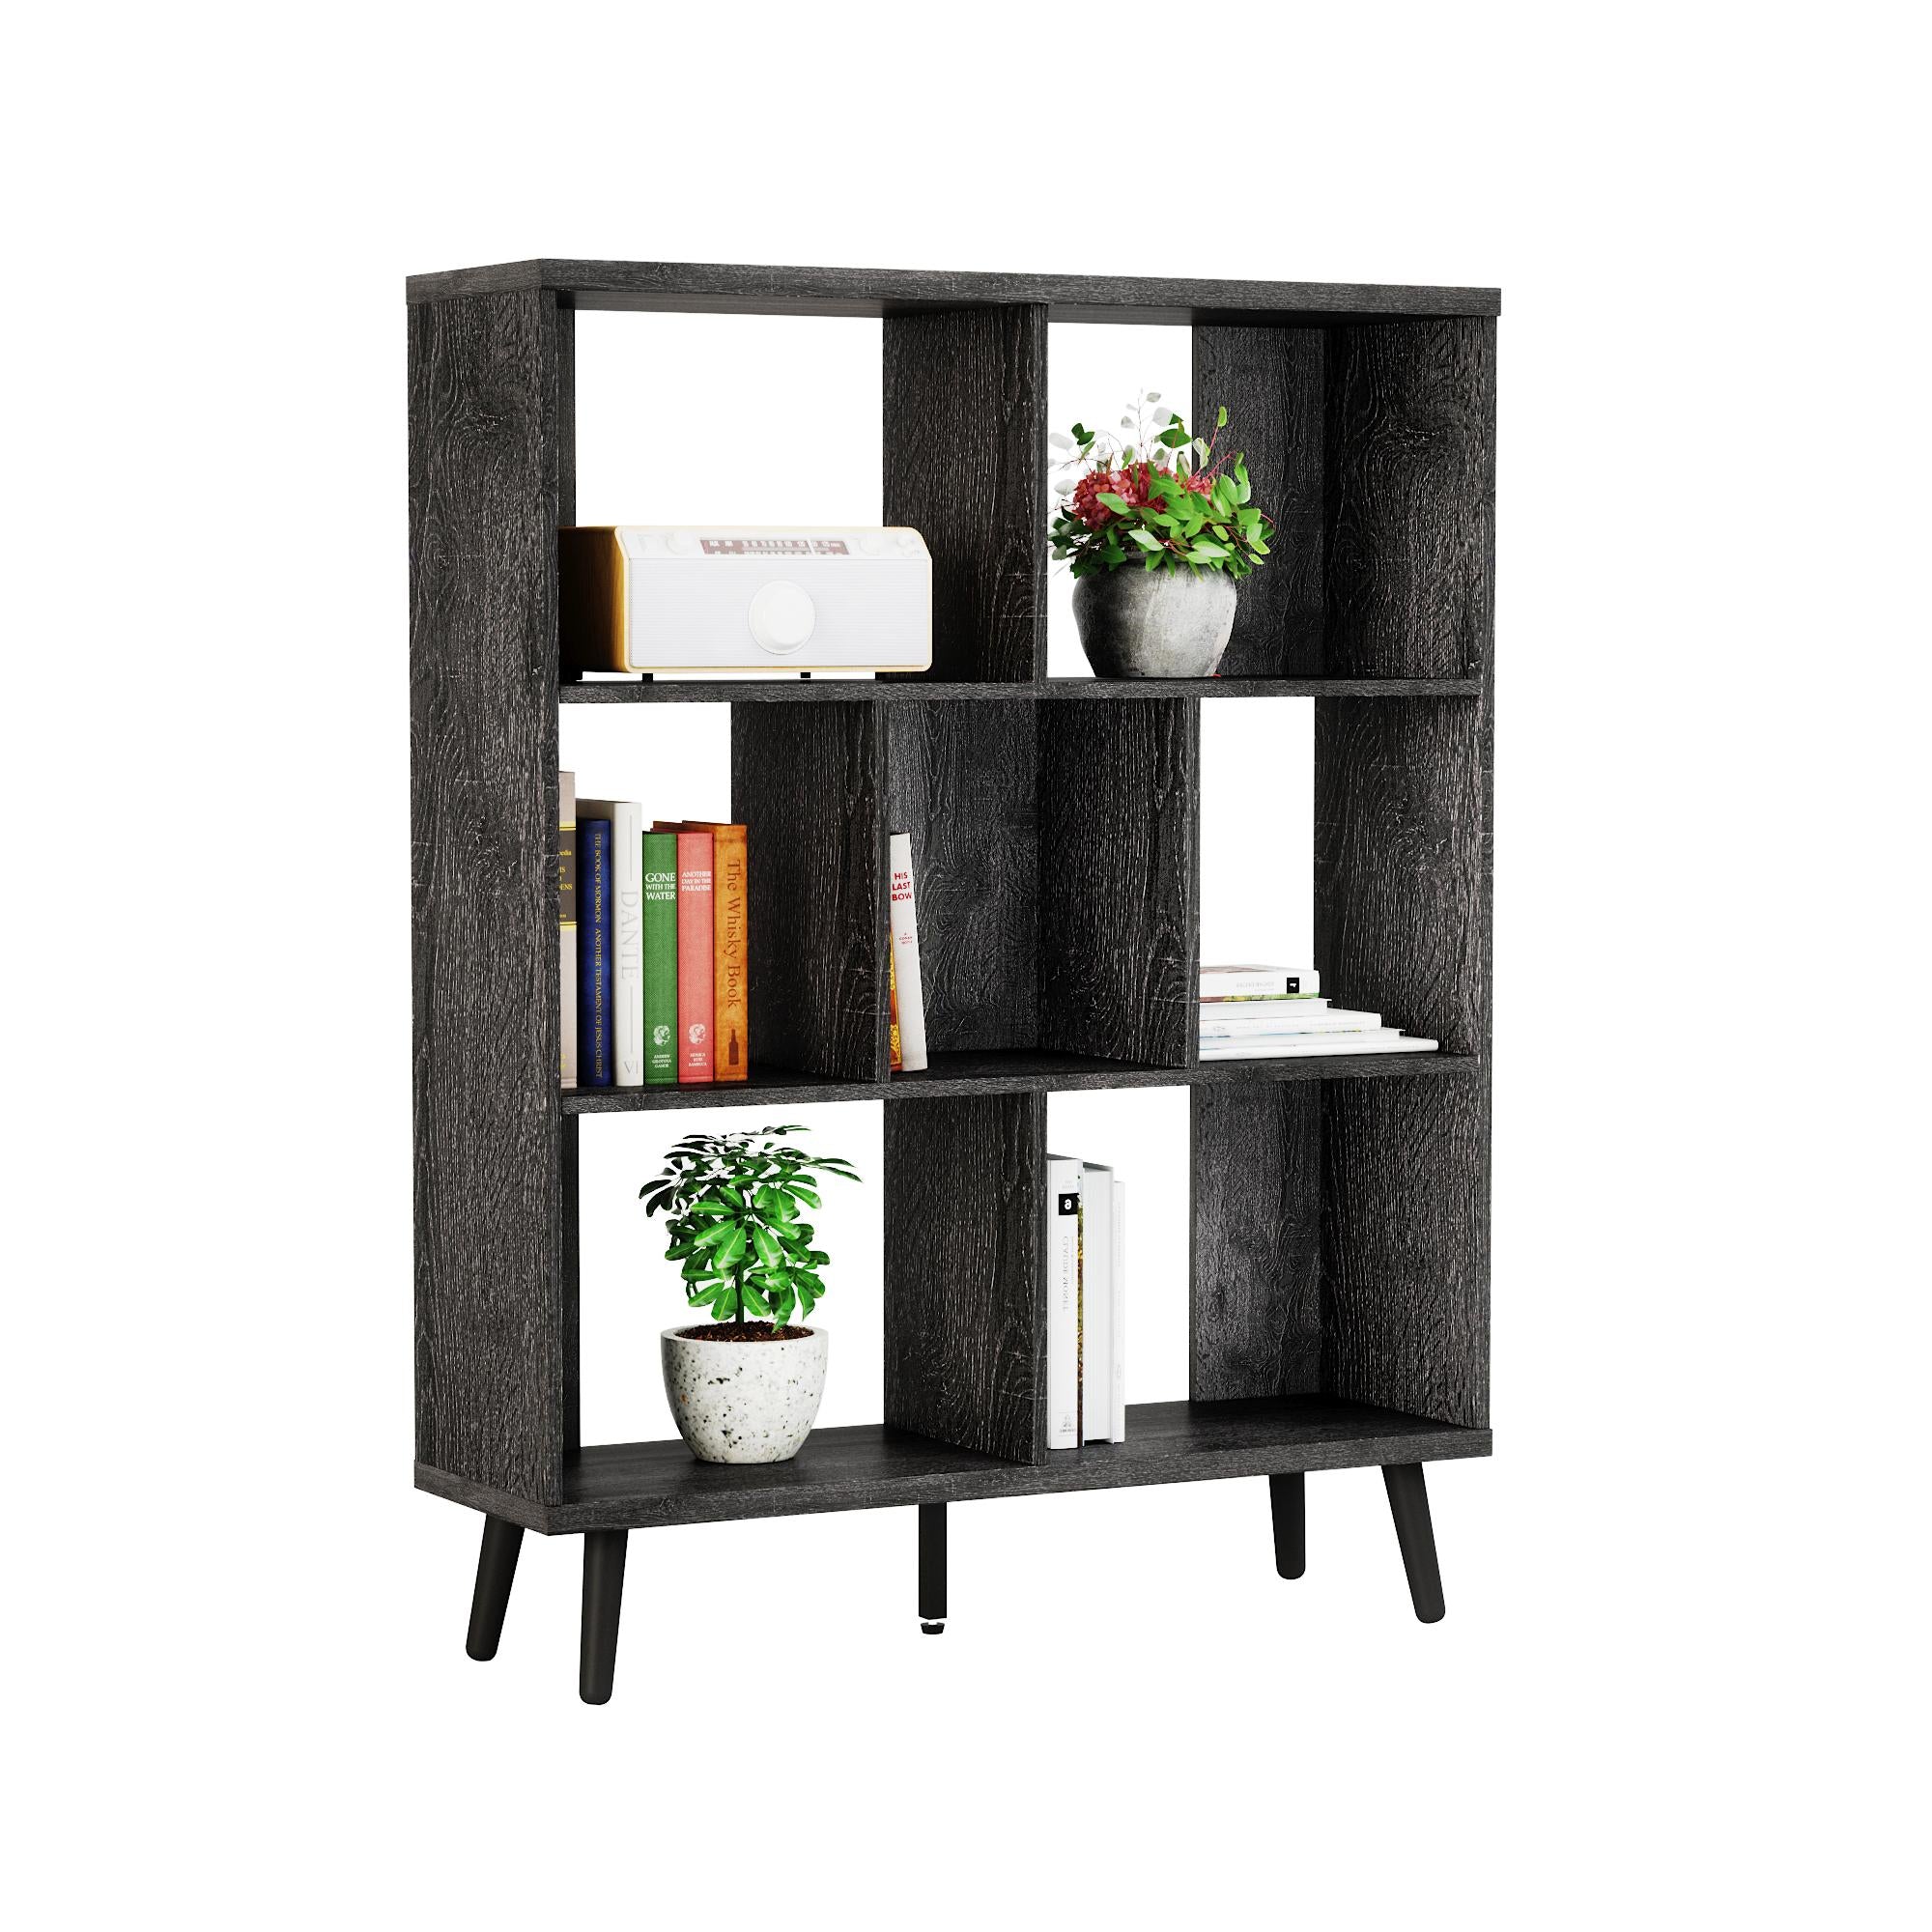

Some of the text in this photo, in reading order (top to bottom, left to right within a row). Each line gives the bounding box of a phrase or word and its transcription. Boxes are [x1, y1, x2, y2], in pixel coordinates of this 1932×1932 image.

[594, 873, 602, 884] OF
[644, 872, 676, 883] GONE
[894, 871, 908, 881] HIS
[892, 881, 911, 892] LAST
[645, 891, 676, 900] WATER
[892, 893, 912, 901] BOW
[621, 891, 639, 980] DANTE
[724, 860, 742, 1009] The Whisky Book
[594, 968, 603, 1013] TESTAMENT
[595, 1014, 603, 1026] OF
[594, 1027, 603, 1048] JESUS
[624, 1062, 639, 1074] VI
